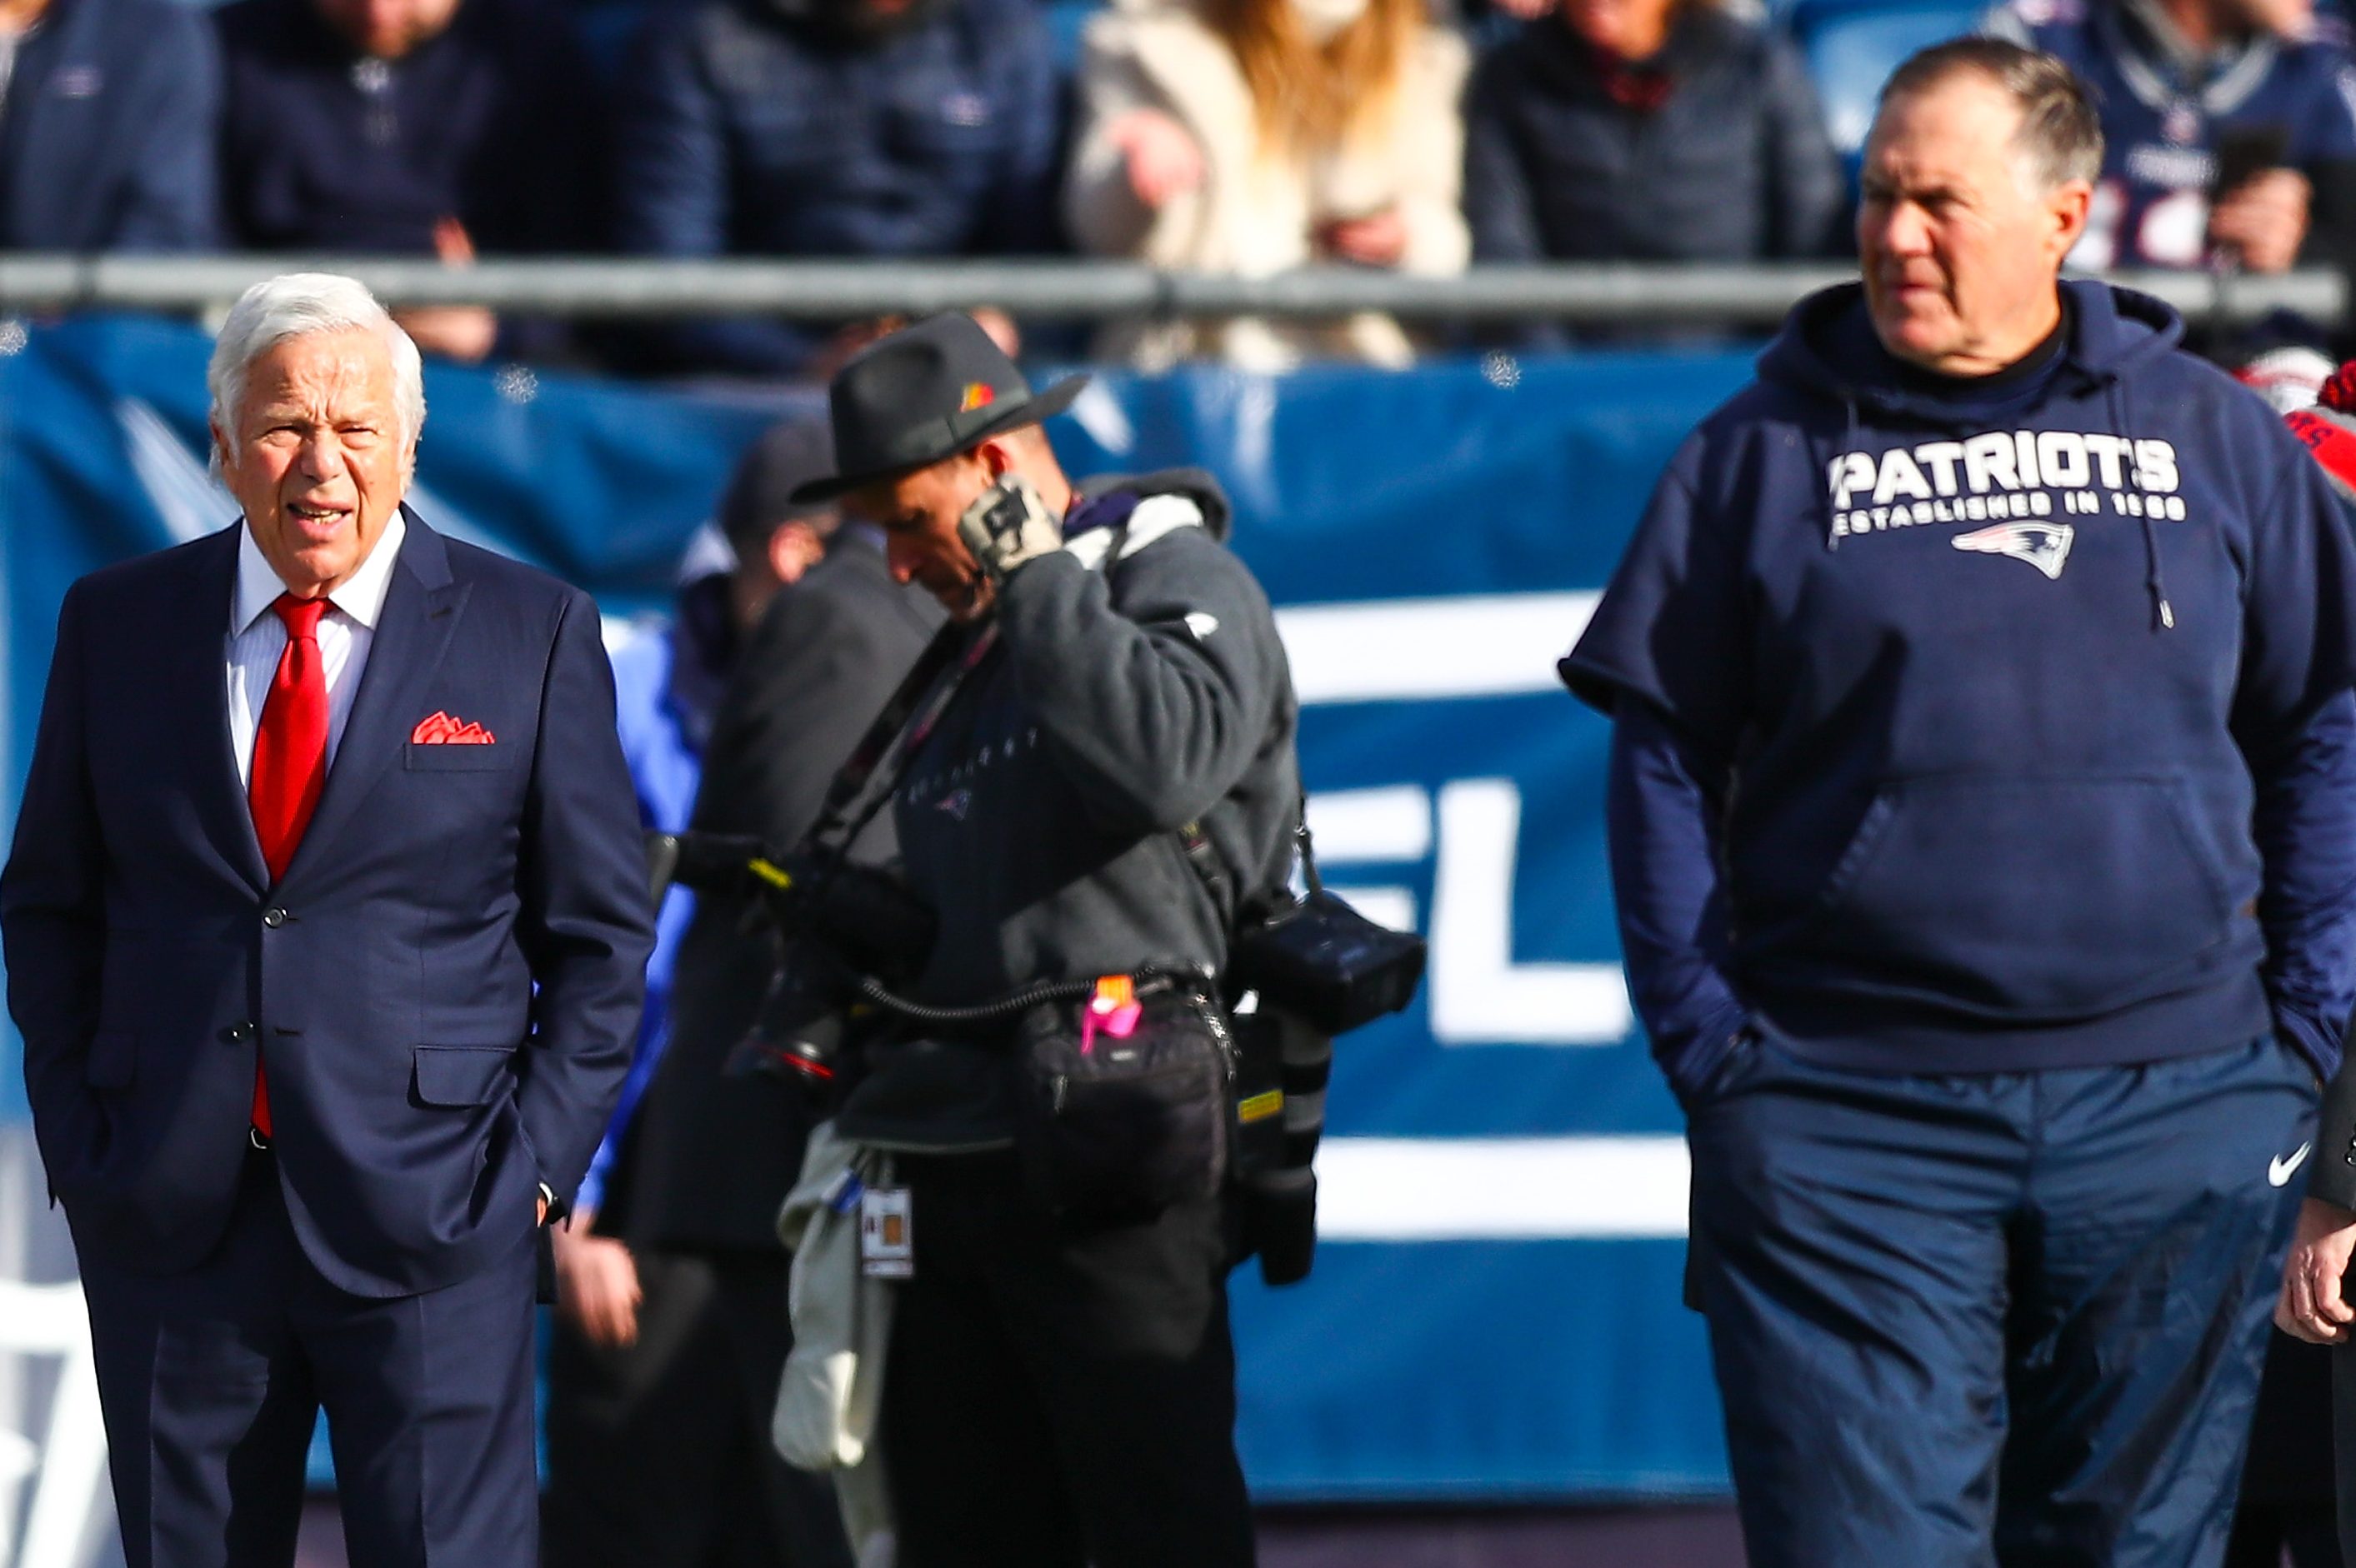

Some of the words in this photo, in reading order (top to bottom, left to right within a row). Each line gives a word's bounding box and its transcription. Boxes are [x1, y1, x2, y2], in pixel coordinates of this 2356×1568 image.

[1827, 430, 2180, 510] PATRIOTS
[1833, 491, 2052, 537] ESTABLISHED
[2063, 490, 2100, 516] IN
